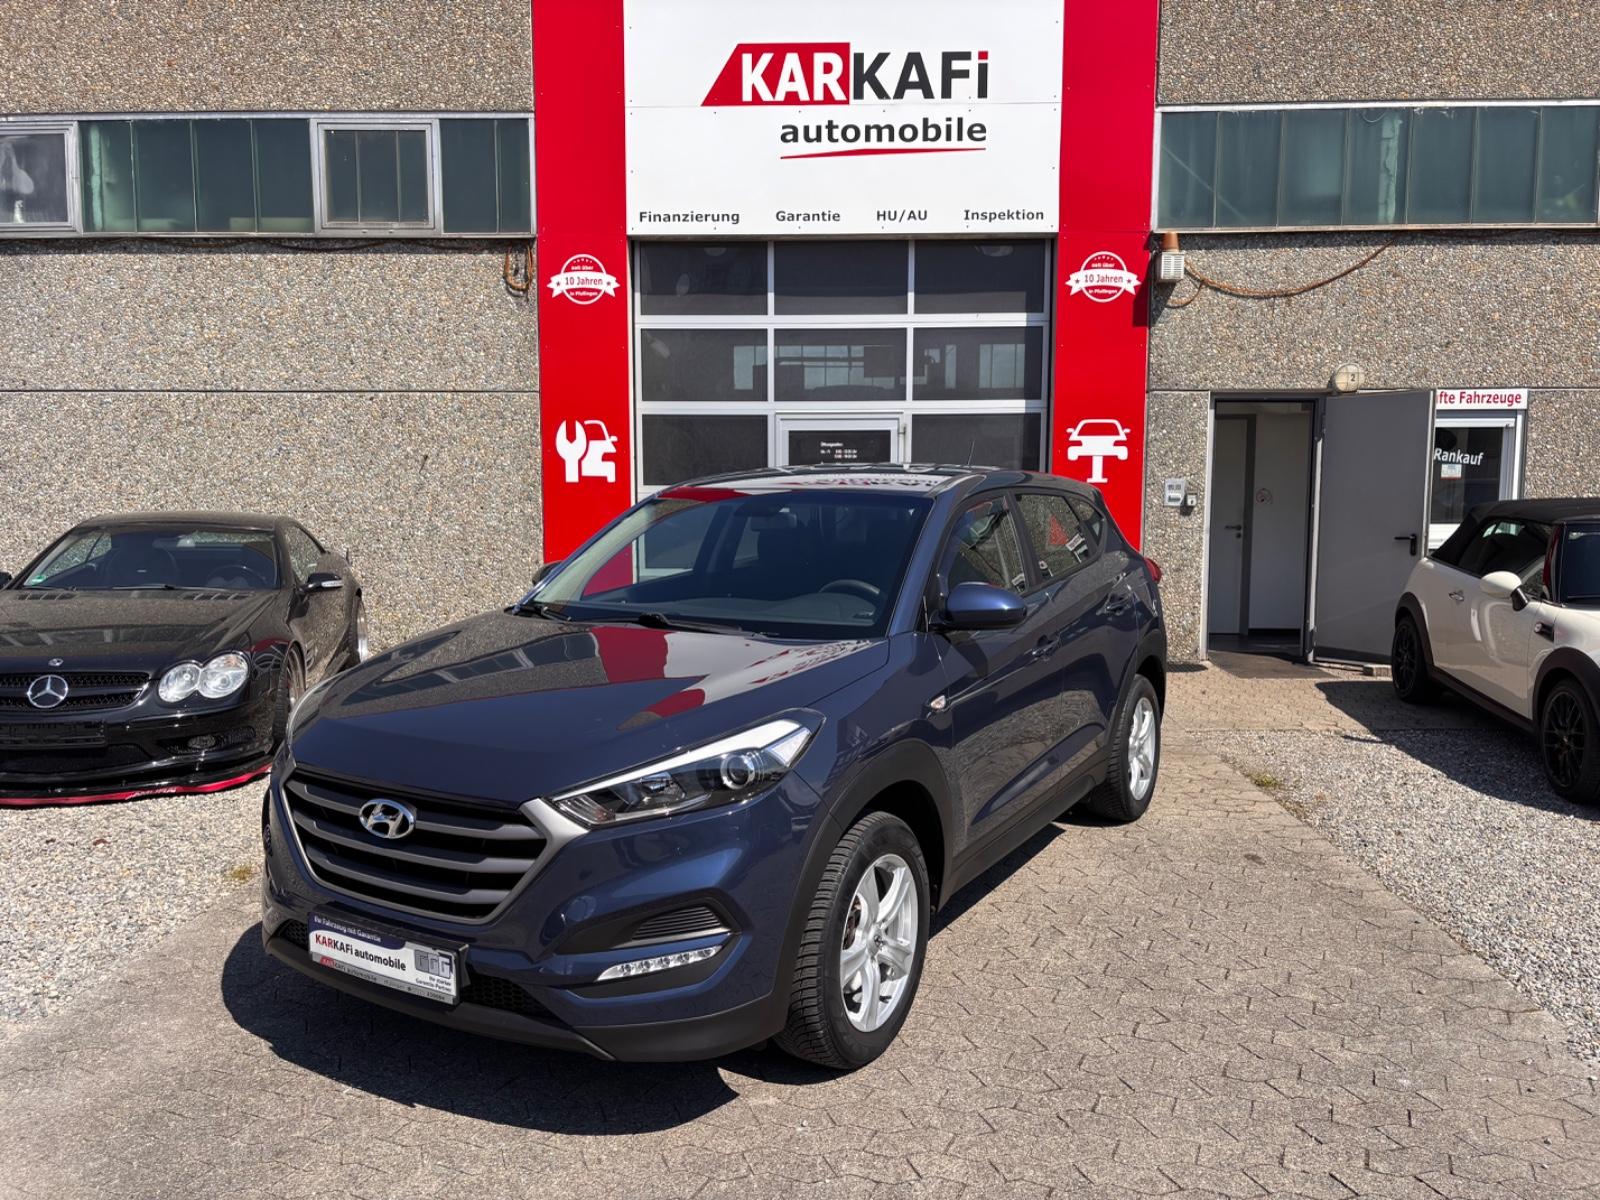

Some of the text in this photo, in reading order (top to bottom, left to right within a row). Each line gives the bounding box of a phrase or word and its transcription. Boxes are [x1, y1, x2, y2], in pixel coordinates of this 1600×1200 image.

[741, 50, 989, 102] KARKAFi
[780, 117, 987, 144] automobile
[639, 209, 1044, 225] Finanzierung Garantie HU/AU Inspektion
[565, 275, 603, 286] 10 Jahren
[1084, 273, 1124, 283] 10 Jahren
[1436, 391, 1522, 407] fte Fahrzeuge
[315, 934, 353, 955] KARKAFi
[354, 947, 406, 972] automobile
